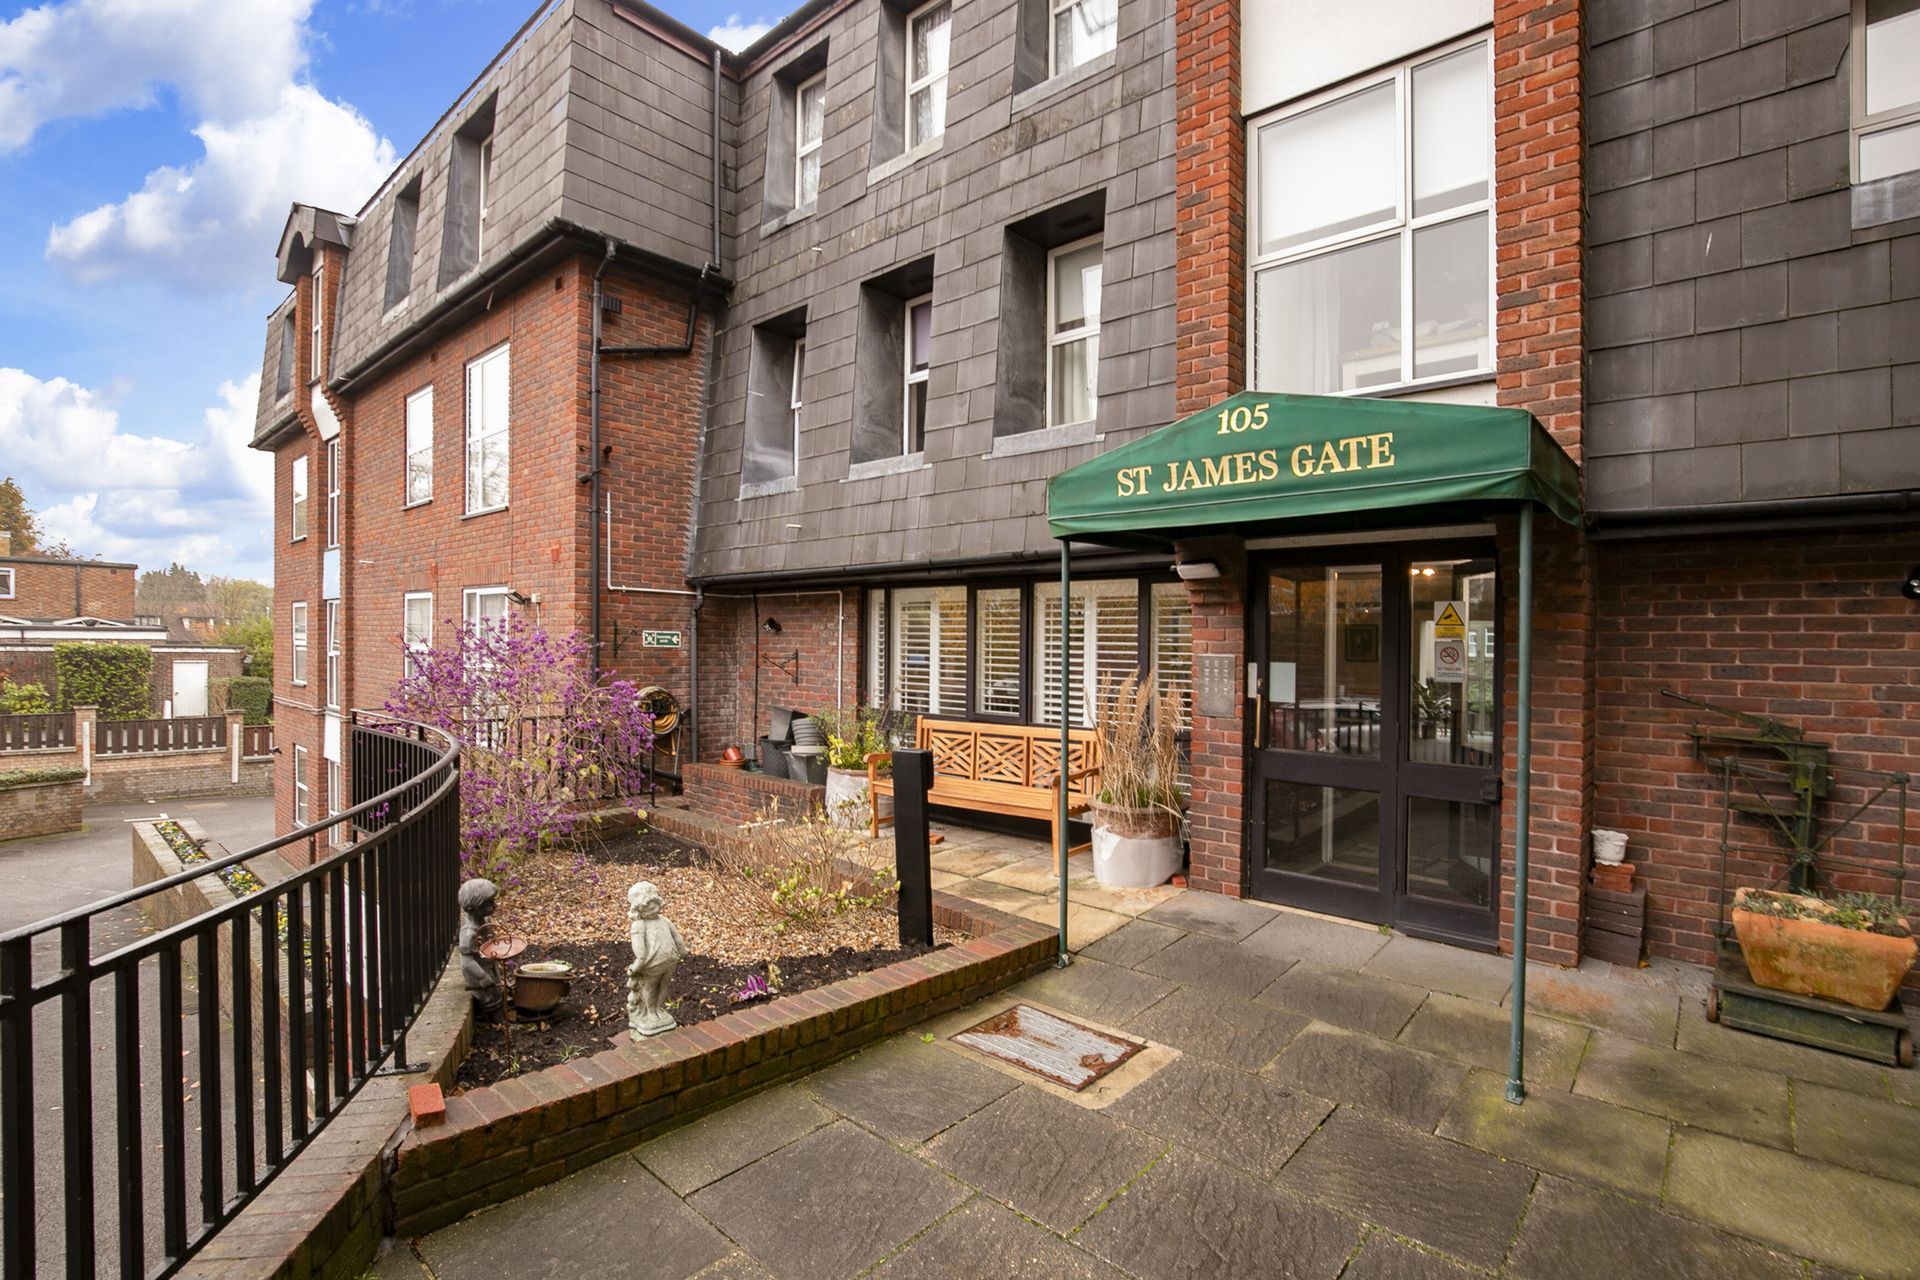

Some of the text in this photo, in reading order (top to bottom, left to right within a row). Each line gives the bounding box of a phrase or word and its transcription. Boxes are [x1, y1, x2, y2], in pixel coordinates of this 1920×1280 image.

[1217, 403, 1269, 434] 105
[1116, 432, 1395, 497] ST JAMES GATE
